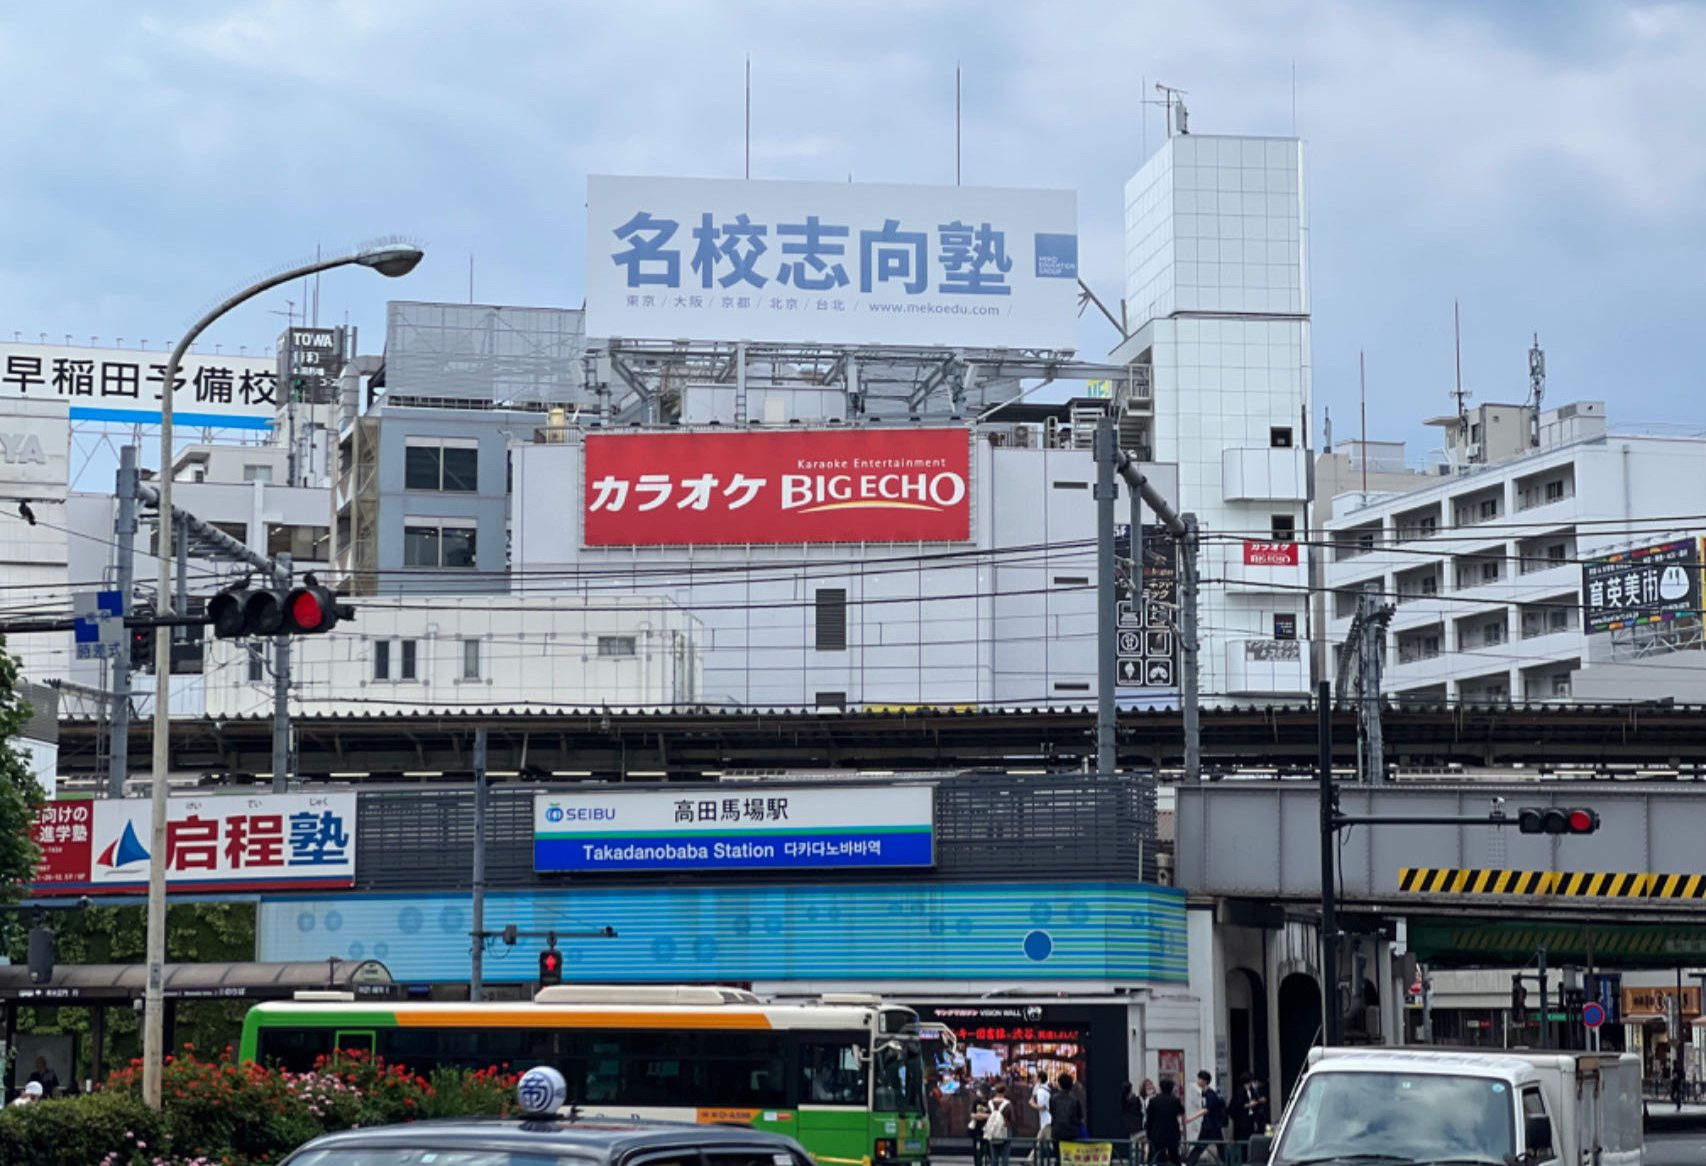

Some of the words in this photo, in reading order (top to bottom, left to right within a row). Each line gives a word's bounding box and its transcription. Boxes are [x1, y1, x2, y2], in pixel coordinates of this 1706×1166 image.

[611, 211, 1013, 296] 名校志向塾
[626, 295, 655, 307] 東京
[673, 296, 703, 308] 大阪
[721, 297, 751, 309] 京都
[769, 298, 798, 310] 北京
[816, 299, 845, 311] 台北
[869, 302, 1000, 316] www.mekoedu.com
[293, 332, 333, 348] TOWA
[2, 355, 278, 406] 早稲田予備校
[797, 459, 848, 469] Karaoke
[854, 457, 947, 469] Entertainment
[589, 473, 767, 512] カラオケ
[781, 475, 851, 510] BIG
[860, 472, 965, 506] ECHO
[566, 808, 616, 821] SEIBU
[674, 798, 789, 823] 高田馬場駅
[583, 843, 708, 861] Takadanobaba
[713, 842, 774, 859] Station
[784, 840, 881, 858] 다카다노바바역
